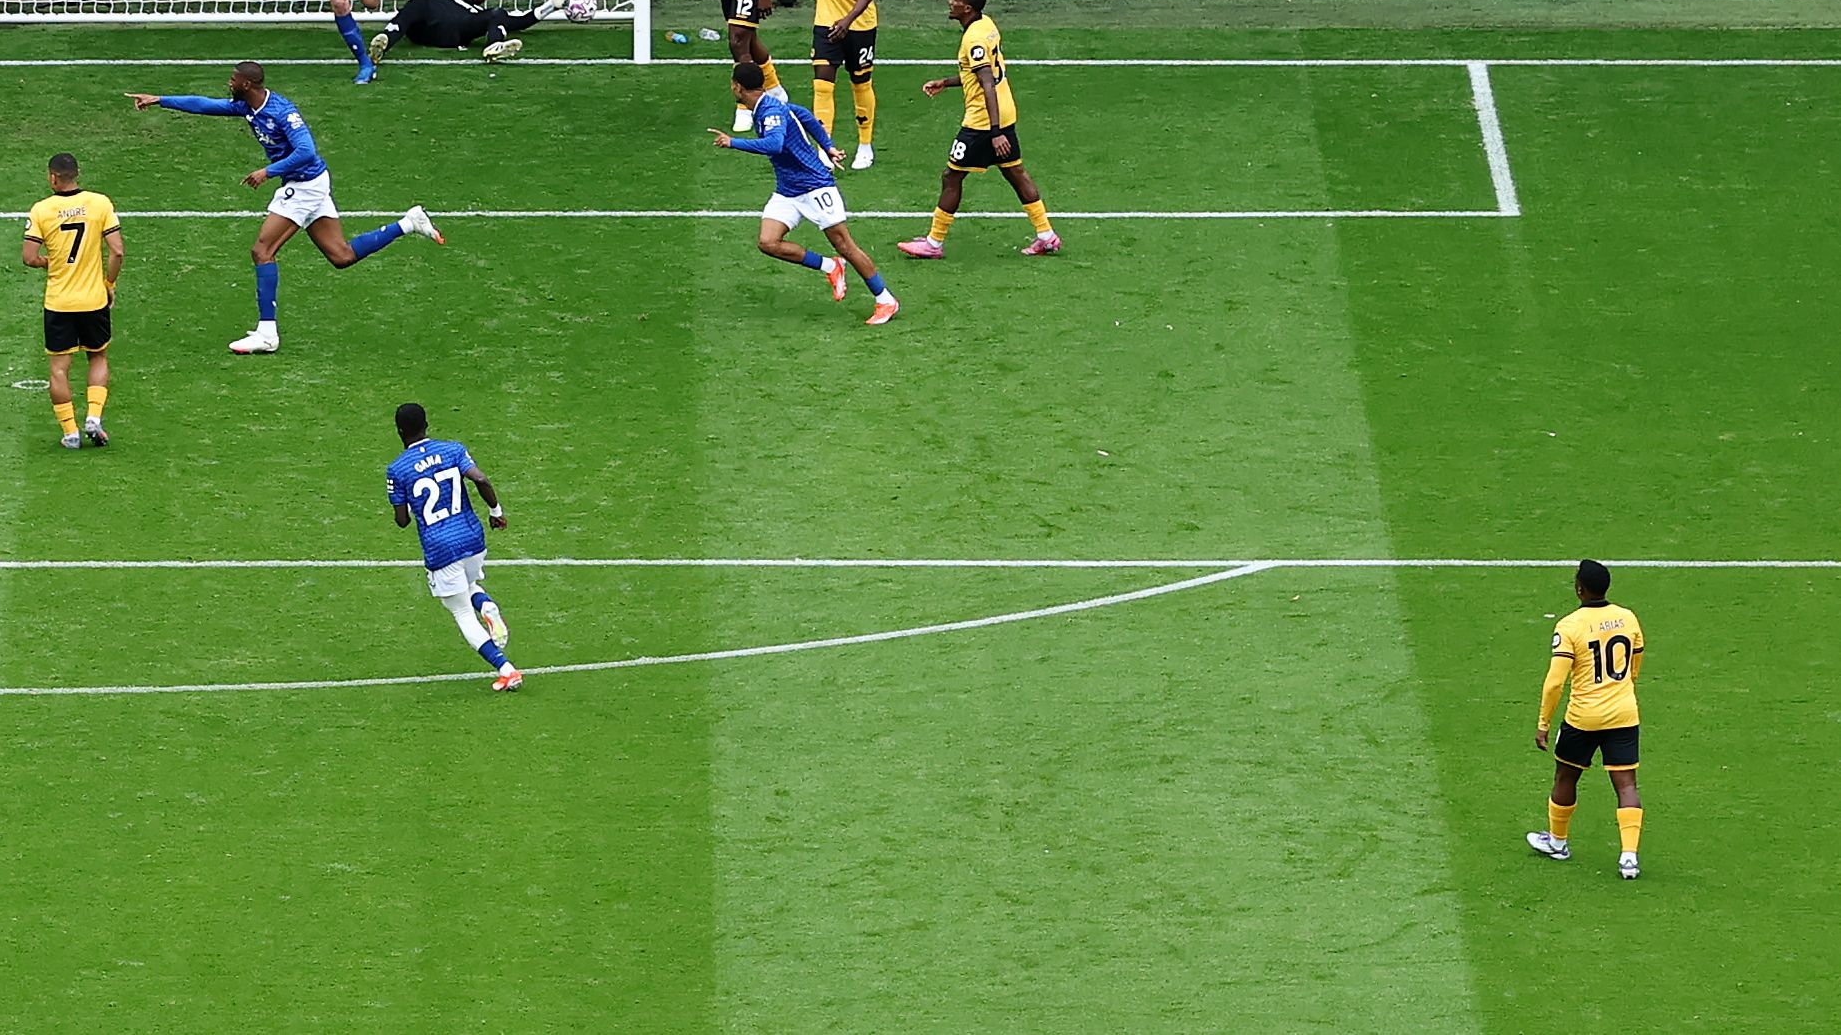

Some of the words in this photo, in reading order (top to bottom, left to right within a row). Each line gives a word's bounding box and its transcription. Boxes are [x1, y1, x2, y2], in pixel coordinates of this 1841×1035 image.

[284, 185, 296, 201] 9
[813, 190, 834, 211] 10
[60, 221, 86, 264] 7
[413, 453, 443, 473] GANA
[412, 465, 462, 526] 27
[1598, 617, 1626, 632] ARIAS
[1587, 633, 1633, 684] 10
